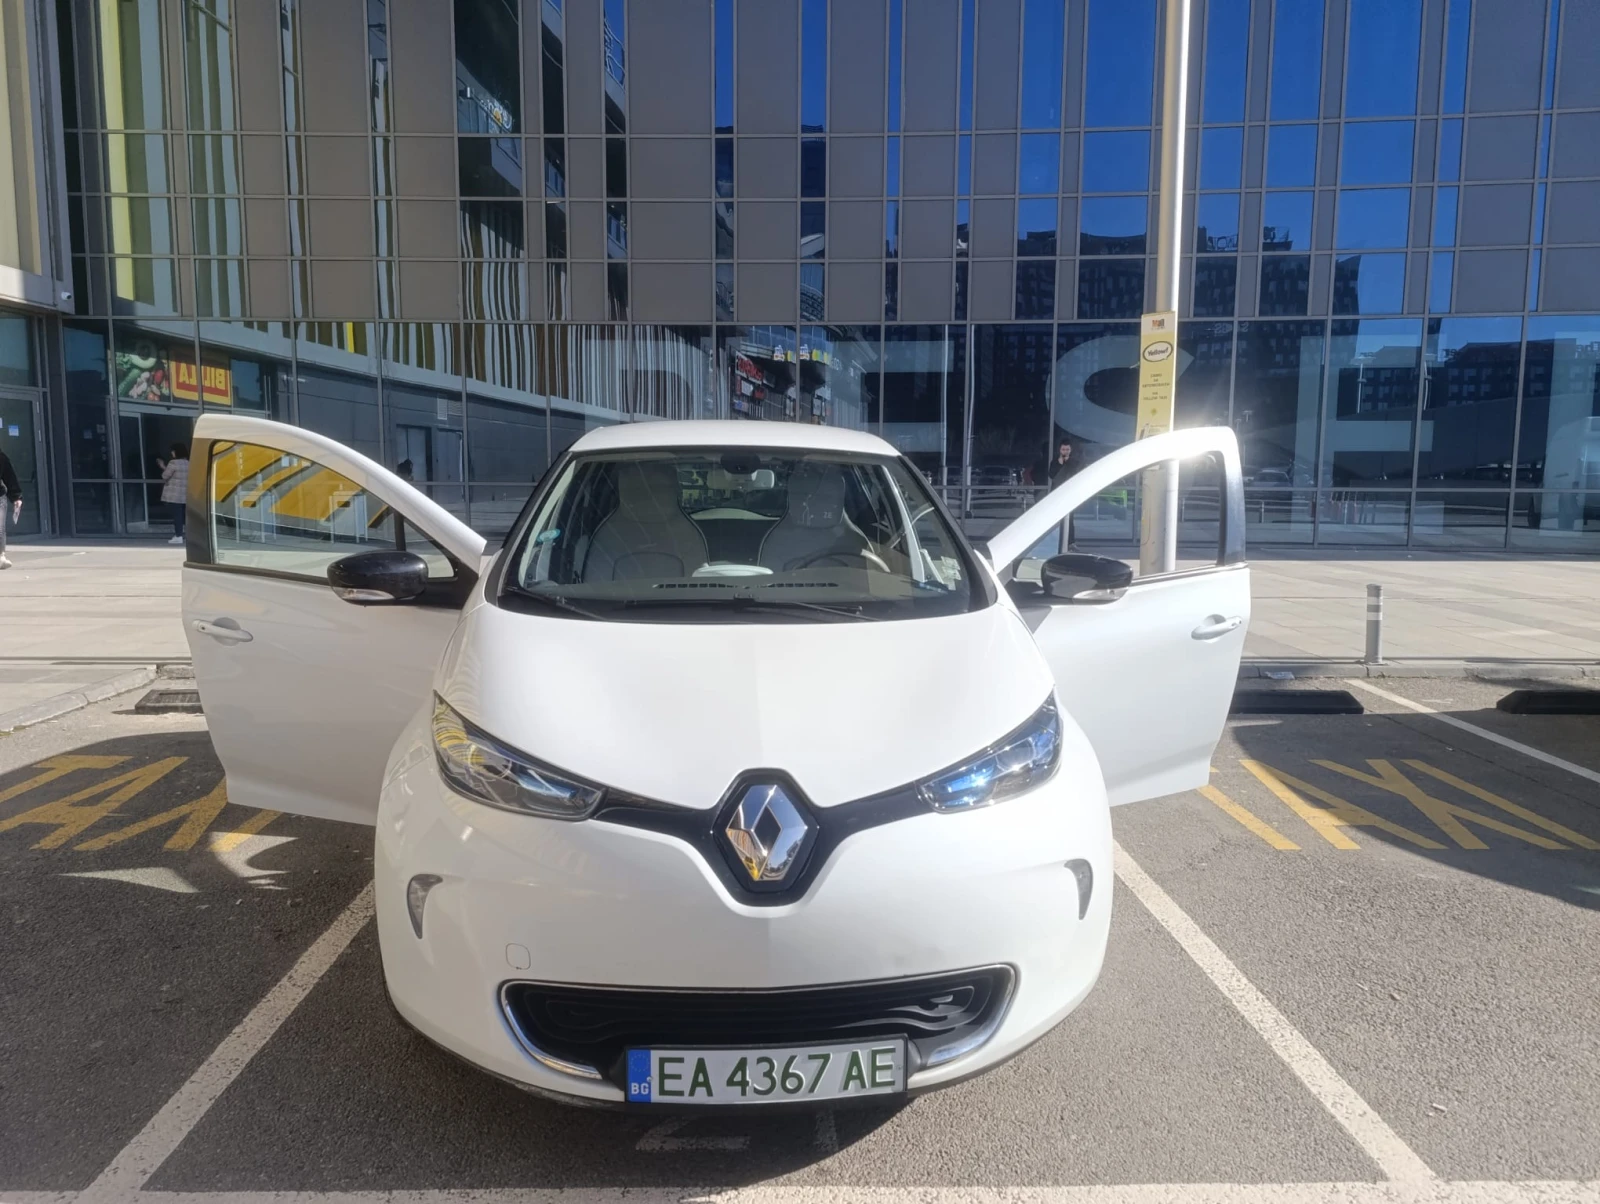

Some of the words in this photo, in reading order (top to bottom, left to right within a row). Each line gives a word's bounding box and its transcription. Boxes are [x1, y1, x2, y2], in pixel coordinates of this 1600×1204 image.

[658, 1057, 714, 1097] EA
[726, 1053, 833, 1097] 4367
[842, 1047, 896, 1091] AE
[631, 1082, 649, 1095] BG
